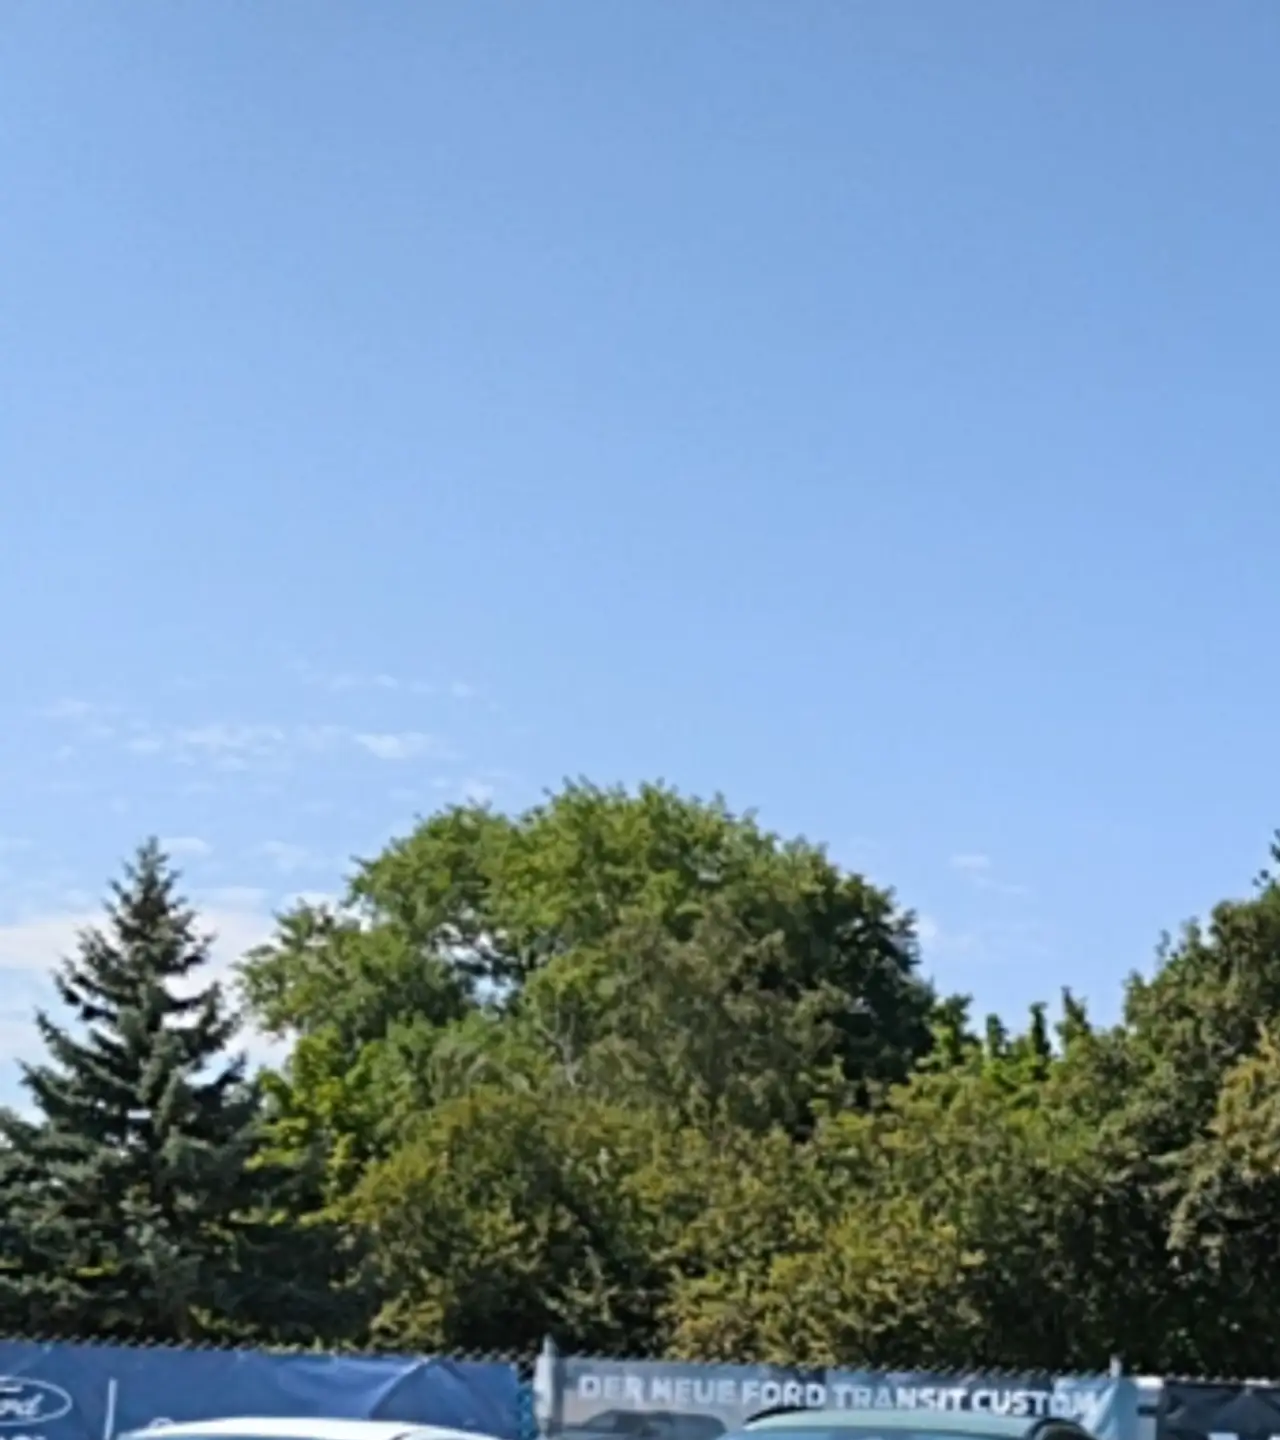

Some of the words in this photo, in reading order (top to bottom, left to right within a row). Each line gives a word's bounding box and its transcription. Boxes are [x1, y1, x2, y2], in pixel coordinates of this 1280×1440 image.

[578, 1375, 645, 1407] DER
[742, 1380, 827, 1407] FORD
[833, 1384, 968, 1411] TRANSIT
[970, 1387, 1096, 1418] CUSTOM
